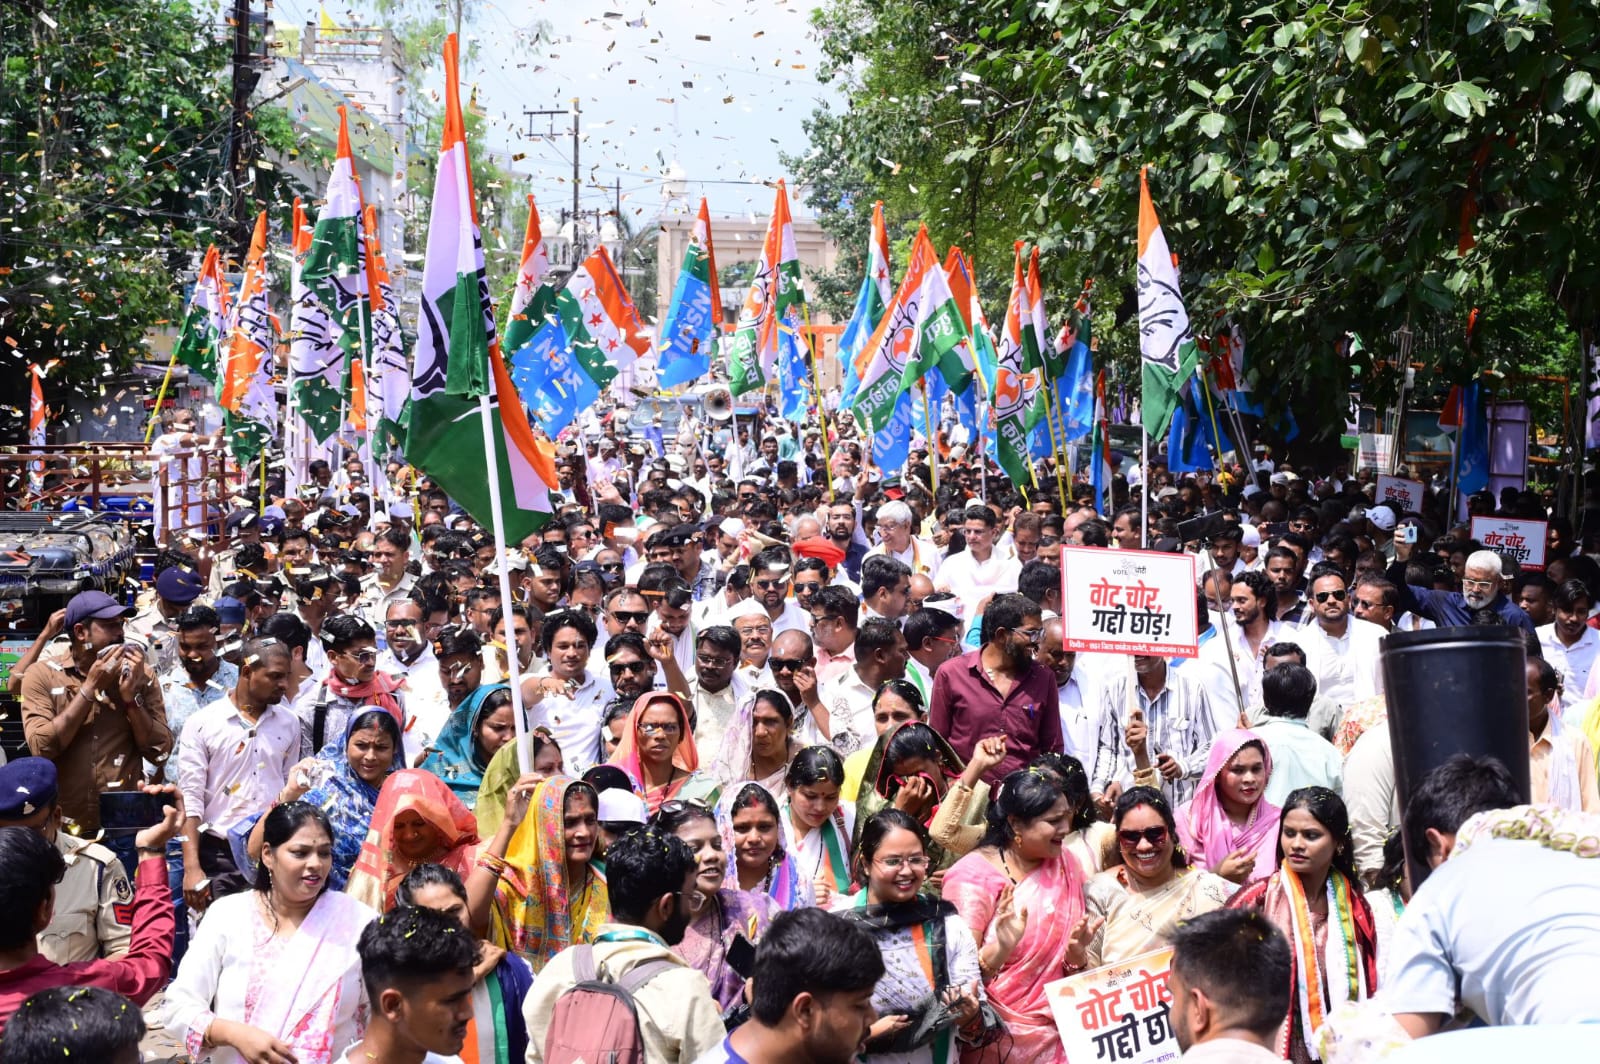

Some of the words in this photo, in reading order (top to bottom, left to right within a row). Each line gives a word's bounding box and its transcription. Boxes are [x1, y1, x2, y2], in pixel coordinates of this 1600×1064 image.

[1484, 531, 1504, 546] वोट
[1505, 532, 1526, 550] चोर,
[1089, 577, 1123, 607] वोट
[1125, 579, 1162, 614] चोर,
[1091, 604, 1127, 635] गद्दी
[1130, 605, 1172, 641] छोड़!
[1075, 988, 1123, 1031] वोट
[1091, 1012, 1140, 1062] गद्दी
[1142, 1000, 1175, 1046] छो
